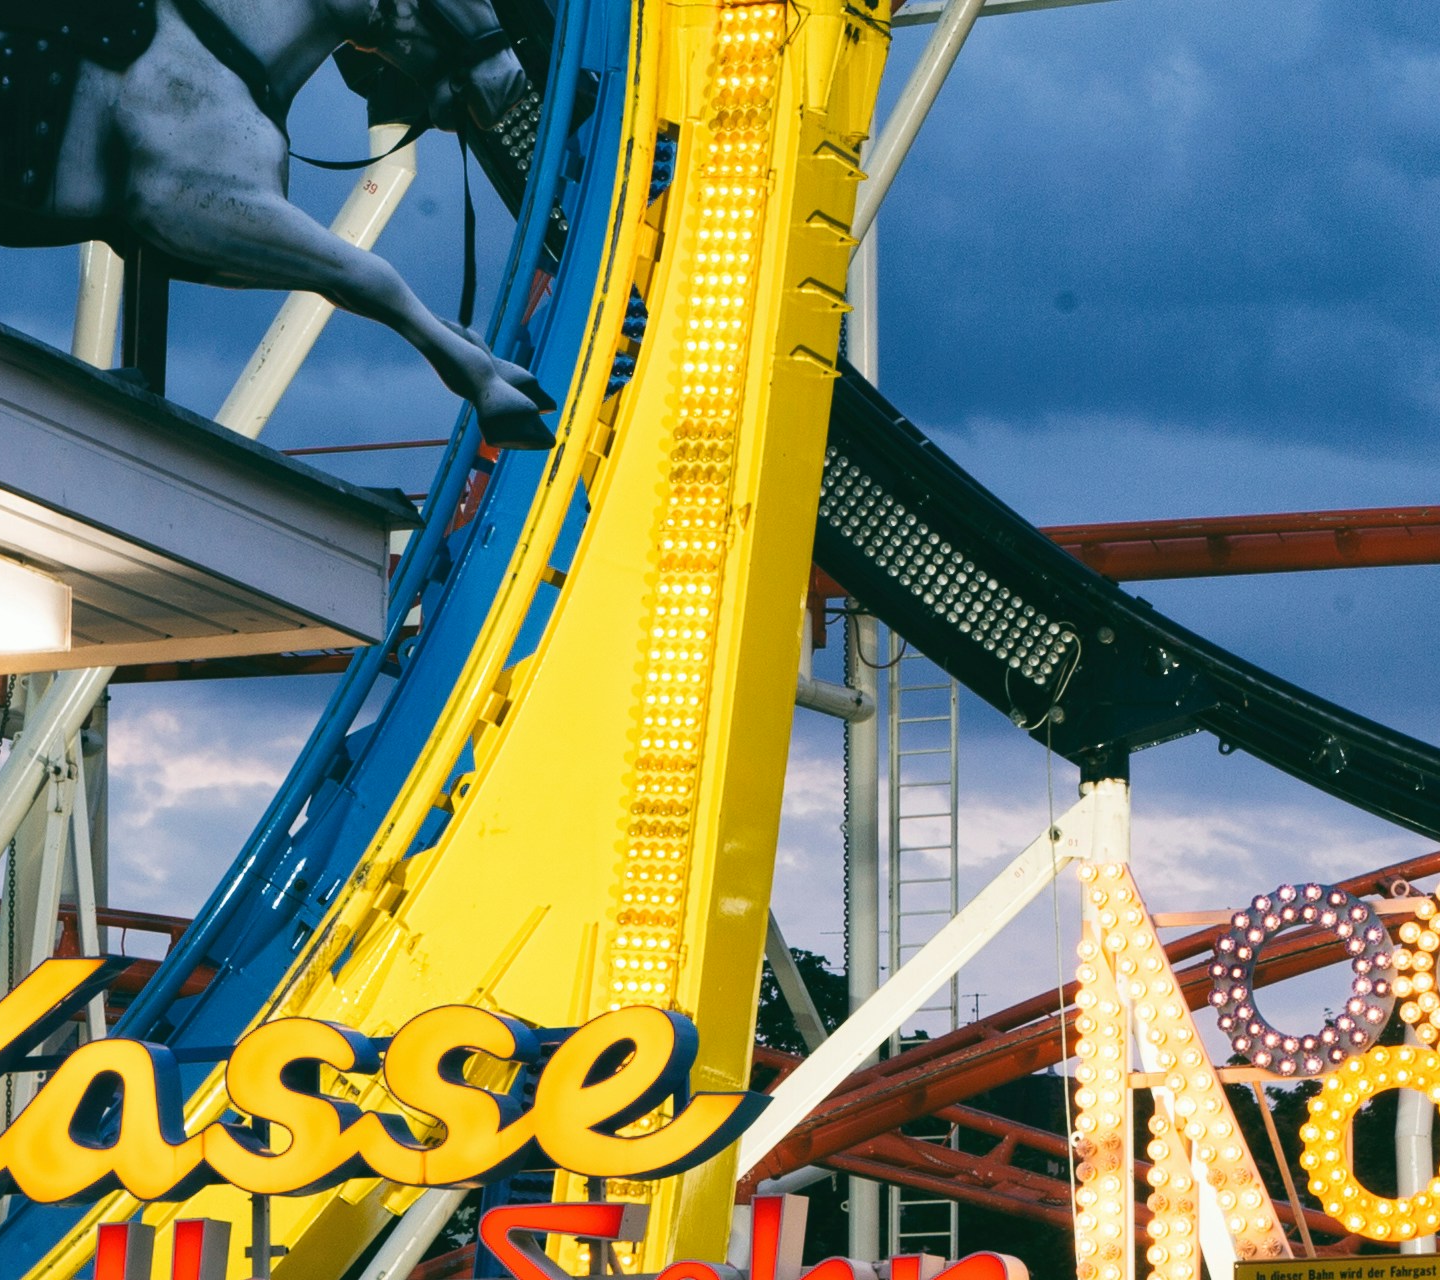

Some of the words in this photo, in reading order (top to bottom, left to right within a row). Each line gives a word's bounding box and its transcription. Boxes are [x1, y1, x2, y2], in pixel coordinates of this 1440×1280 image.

[363, 179, 378, 195] 39
[1308, 1269, 1334, 1280] Bahn
[1340, 1267, 1362, 1279] wird
[1368, 1267, 1385, 1278] der
[1390, 1265, 1436, 1279] Fahrgast
